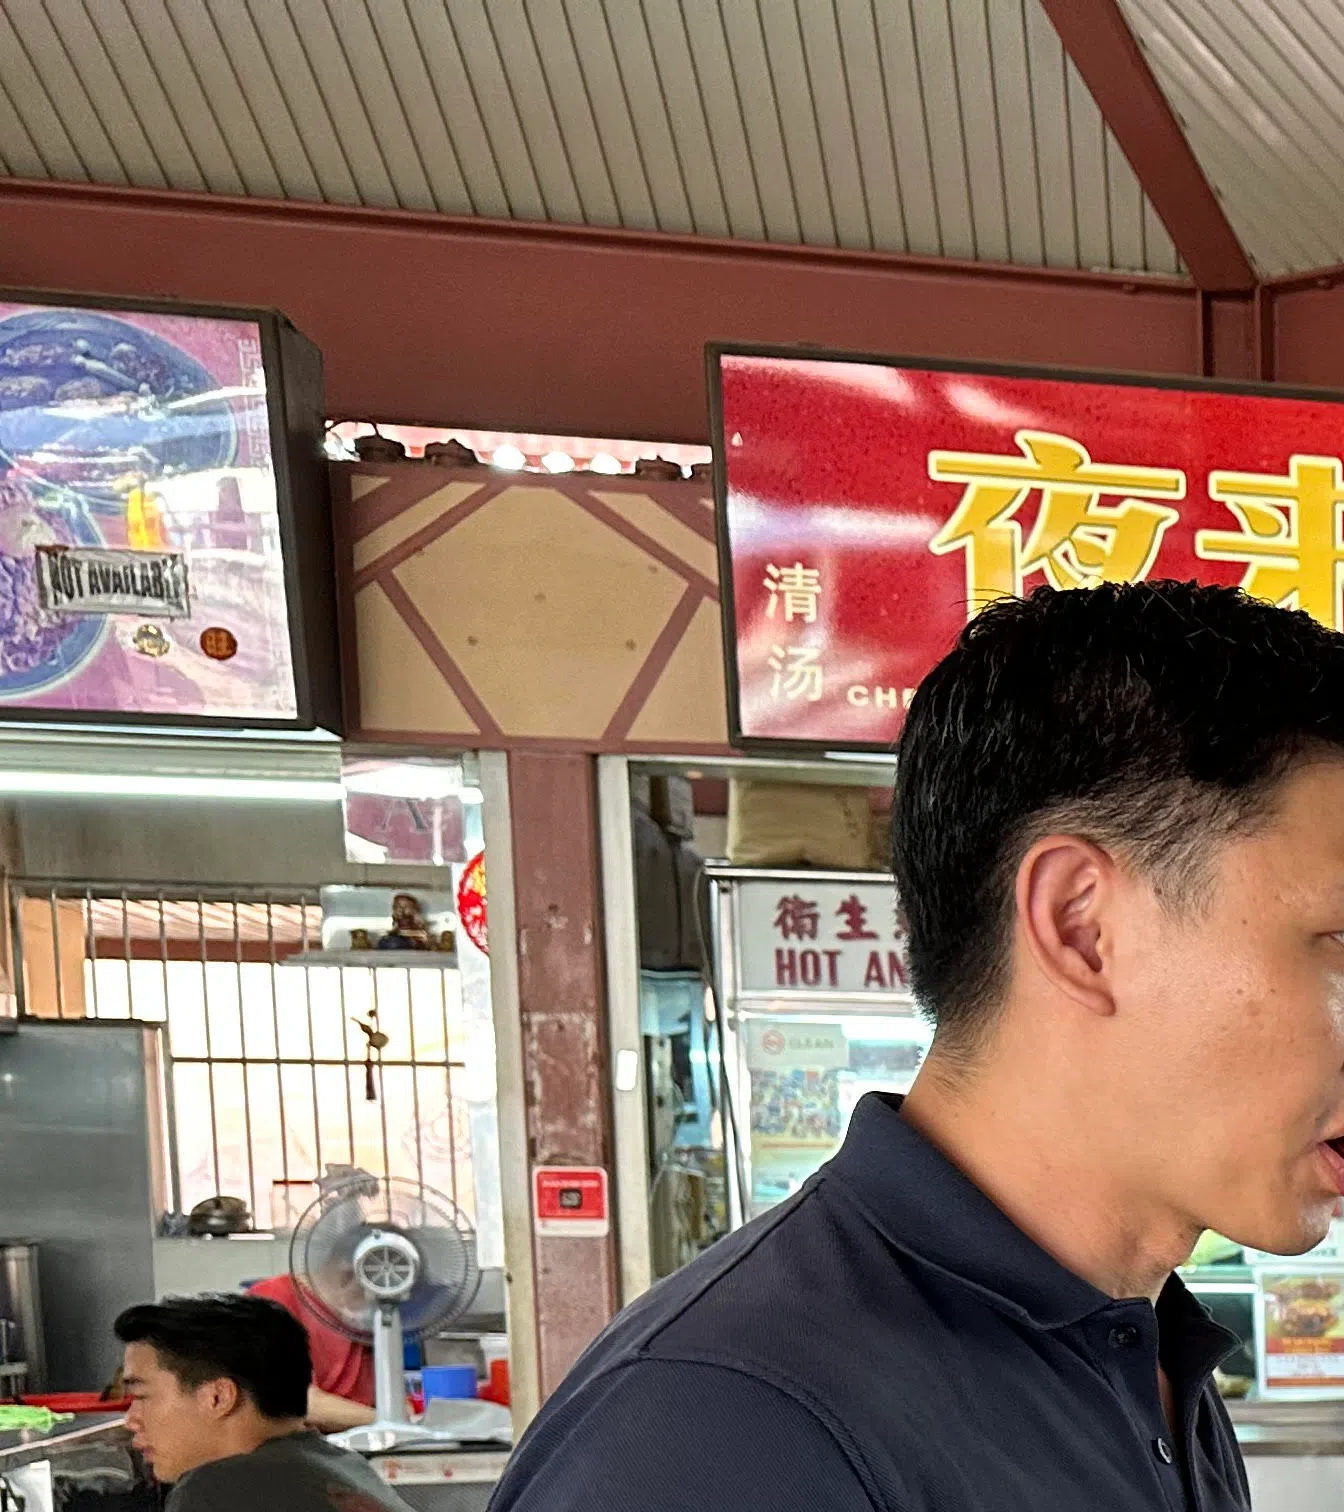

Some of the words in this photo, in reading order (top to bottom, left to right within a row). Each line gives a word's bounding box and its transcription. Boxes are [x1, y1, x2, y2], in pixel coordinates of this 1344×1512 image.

[48, 551, 84, 606] NOT
[762, 563, 824, 702] 清汤
[774, 893, 907, 942] 衛生
[775, 946, 842, 987] HOT
